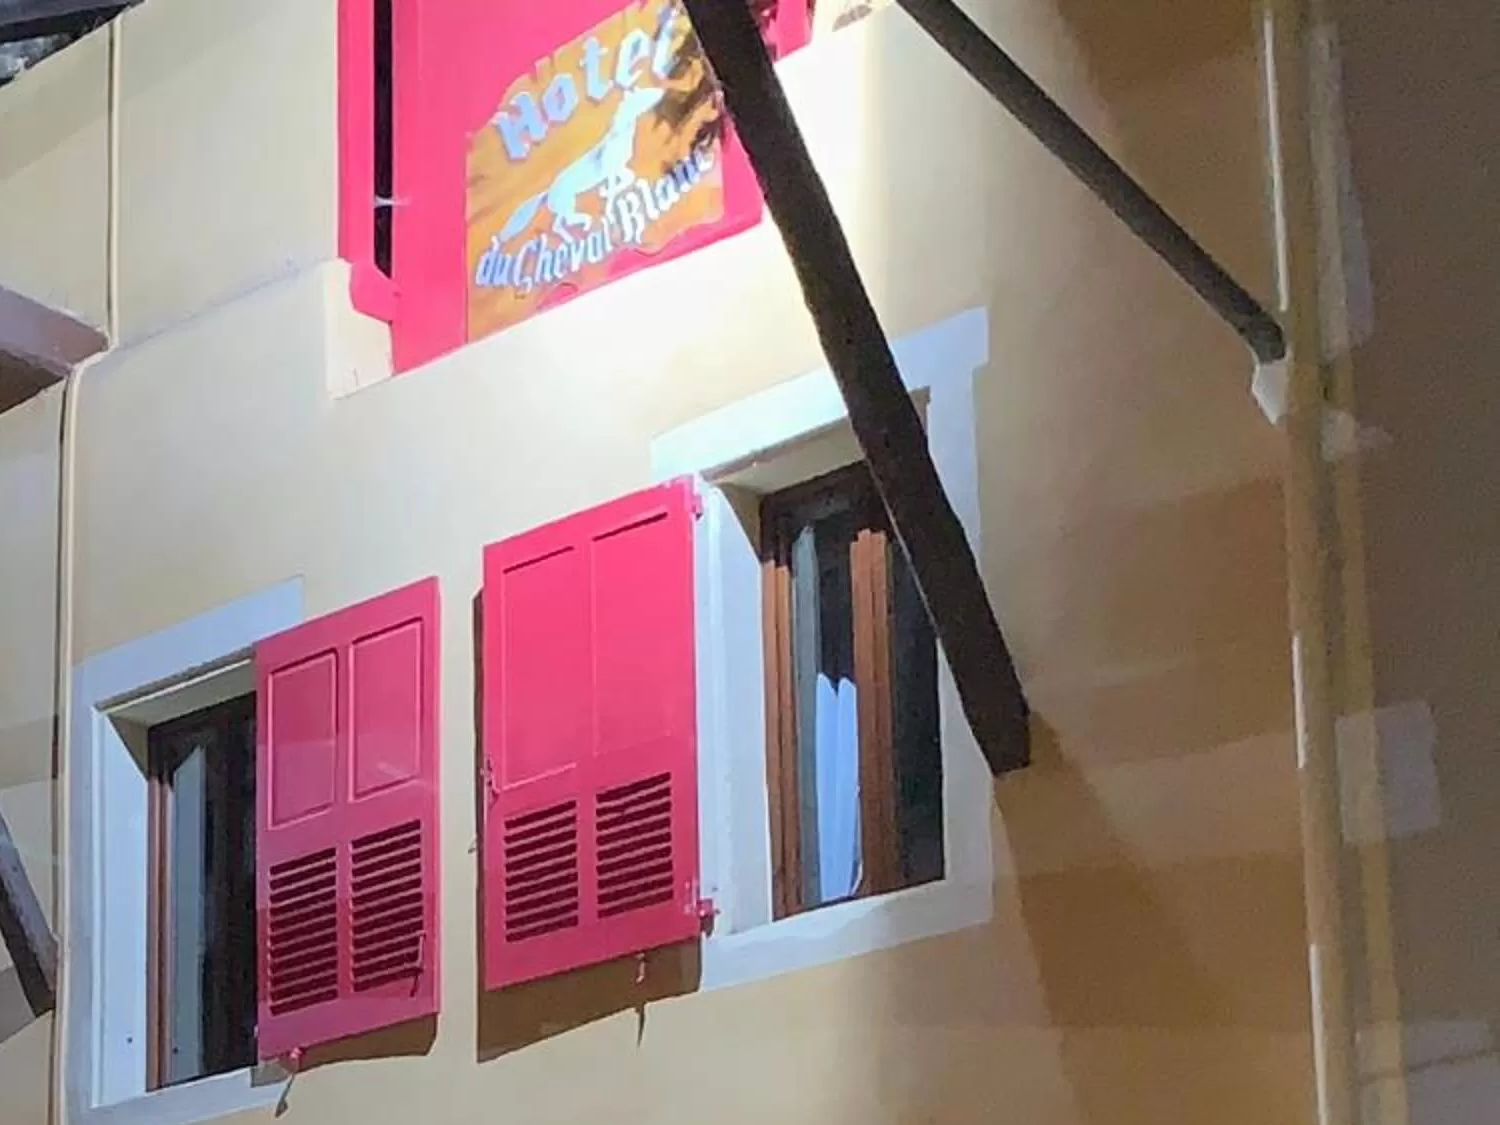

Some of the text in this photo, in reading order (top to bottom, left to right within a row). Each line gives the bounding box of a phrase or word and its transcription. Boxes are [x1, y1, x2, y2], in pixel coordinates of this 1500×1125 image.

[491, 6, 678, 160] Hotel
[476, 142, 715, 292] du Cheval Blanc
